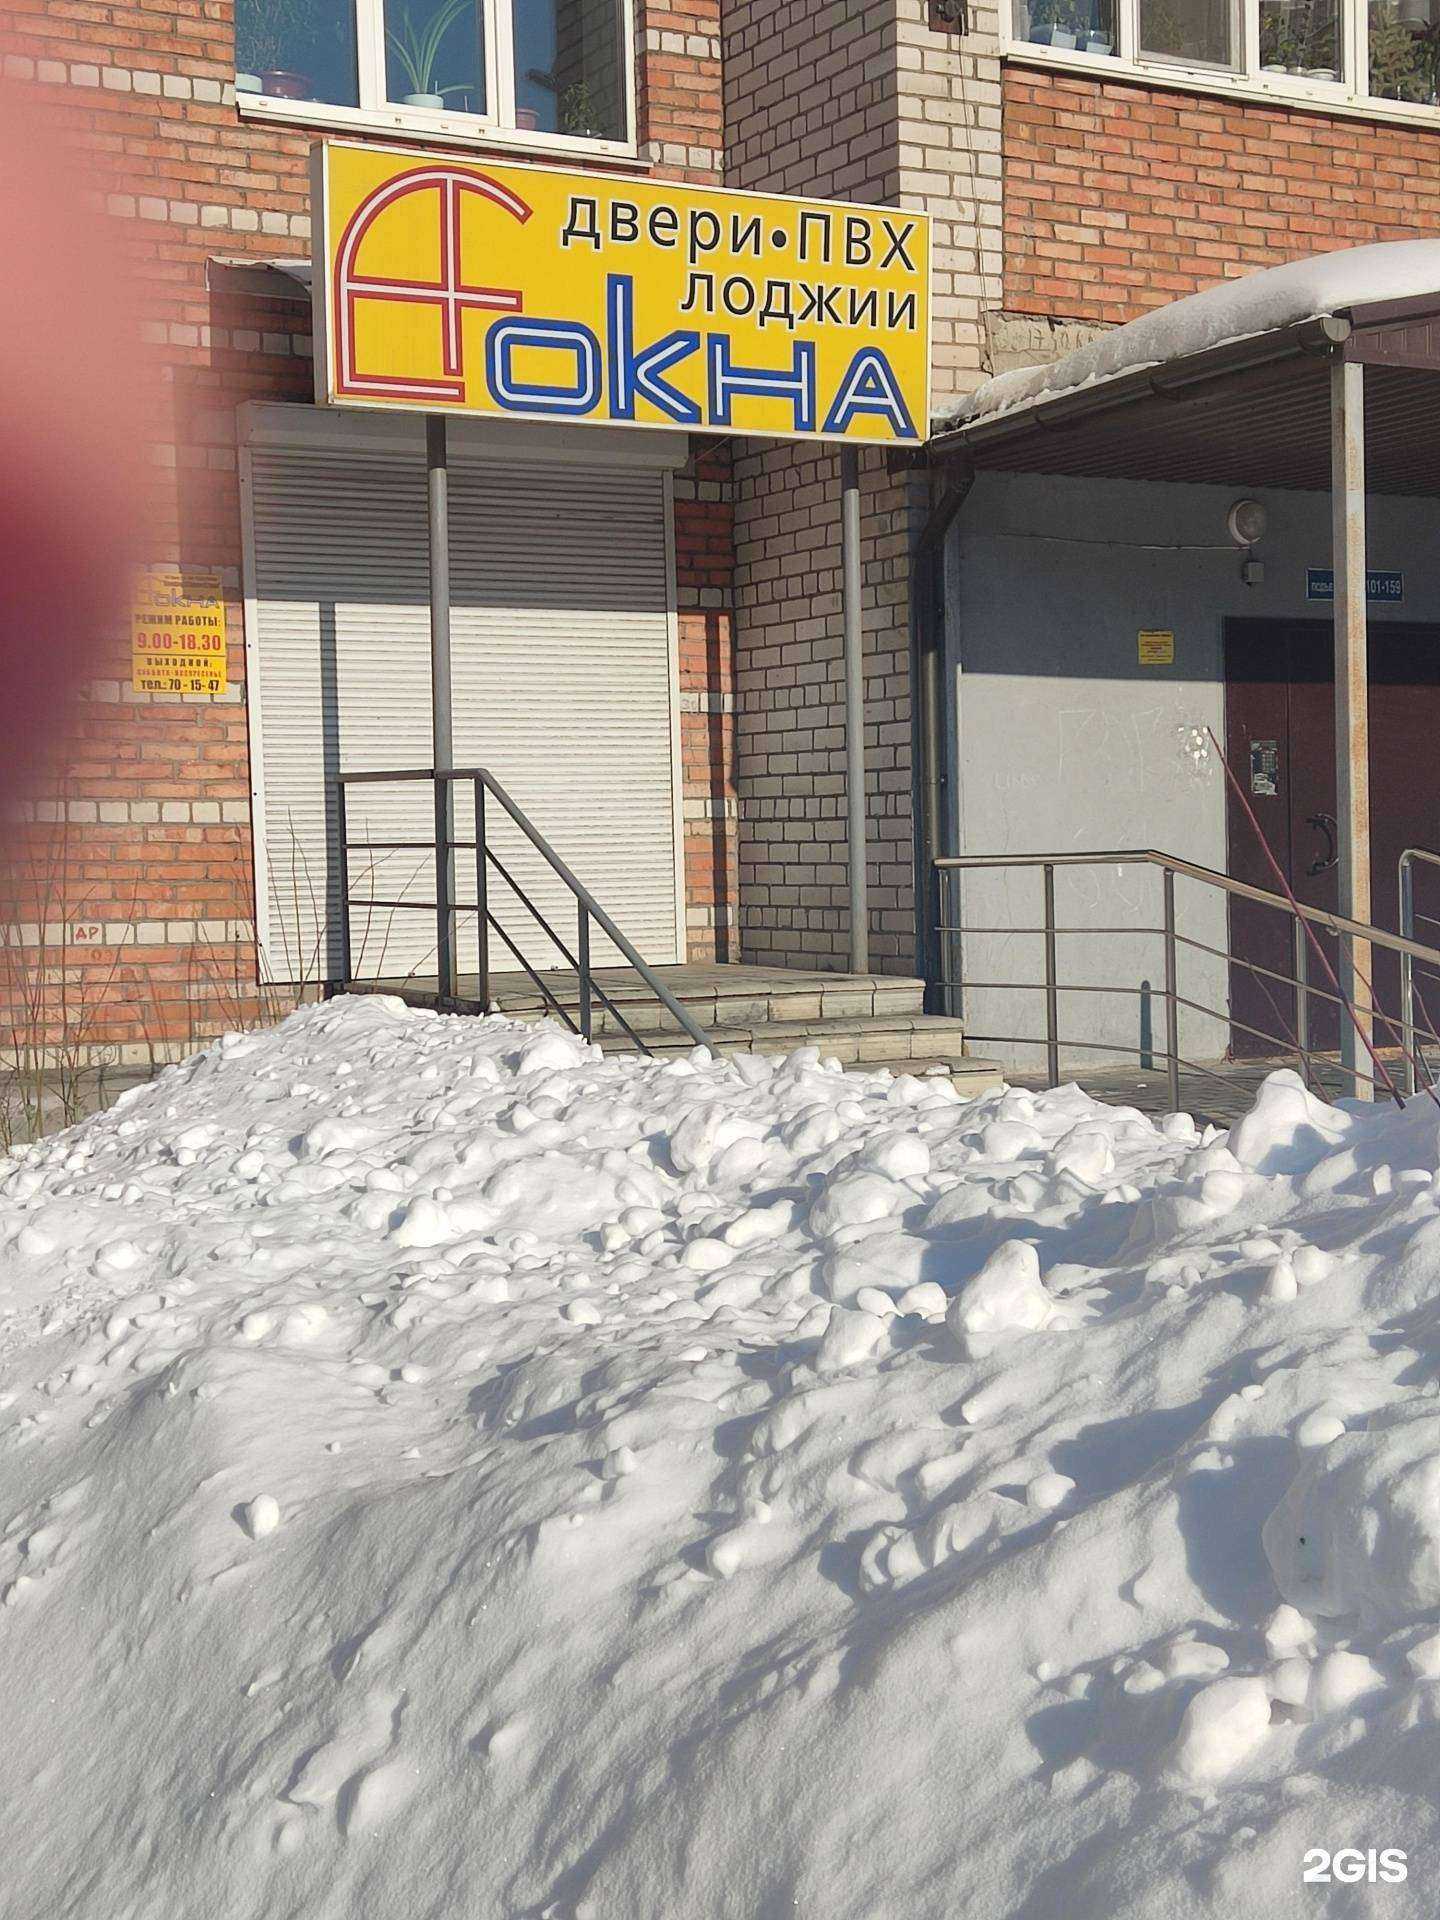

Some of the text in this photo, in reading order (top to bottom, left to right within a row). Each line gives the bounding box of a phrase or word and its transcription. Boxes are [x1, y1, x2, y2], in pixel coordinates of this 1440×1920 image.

[680, 271, 919, 331] лоджии
[135, 614, 173, 626] РЕЖИМ
[137, 632, 221, 651] 9.00-18.30
